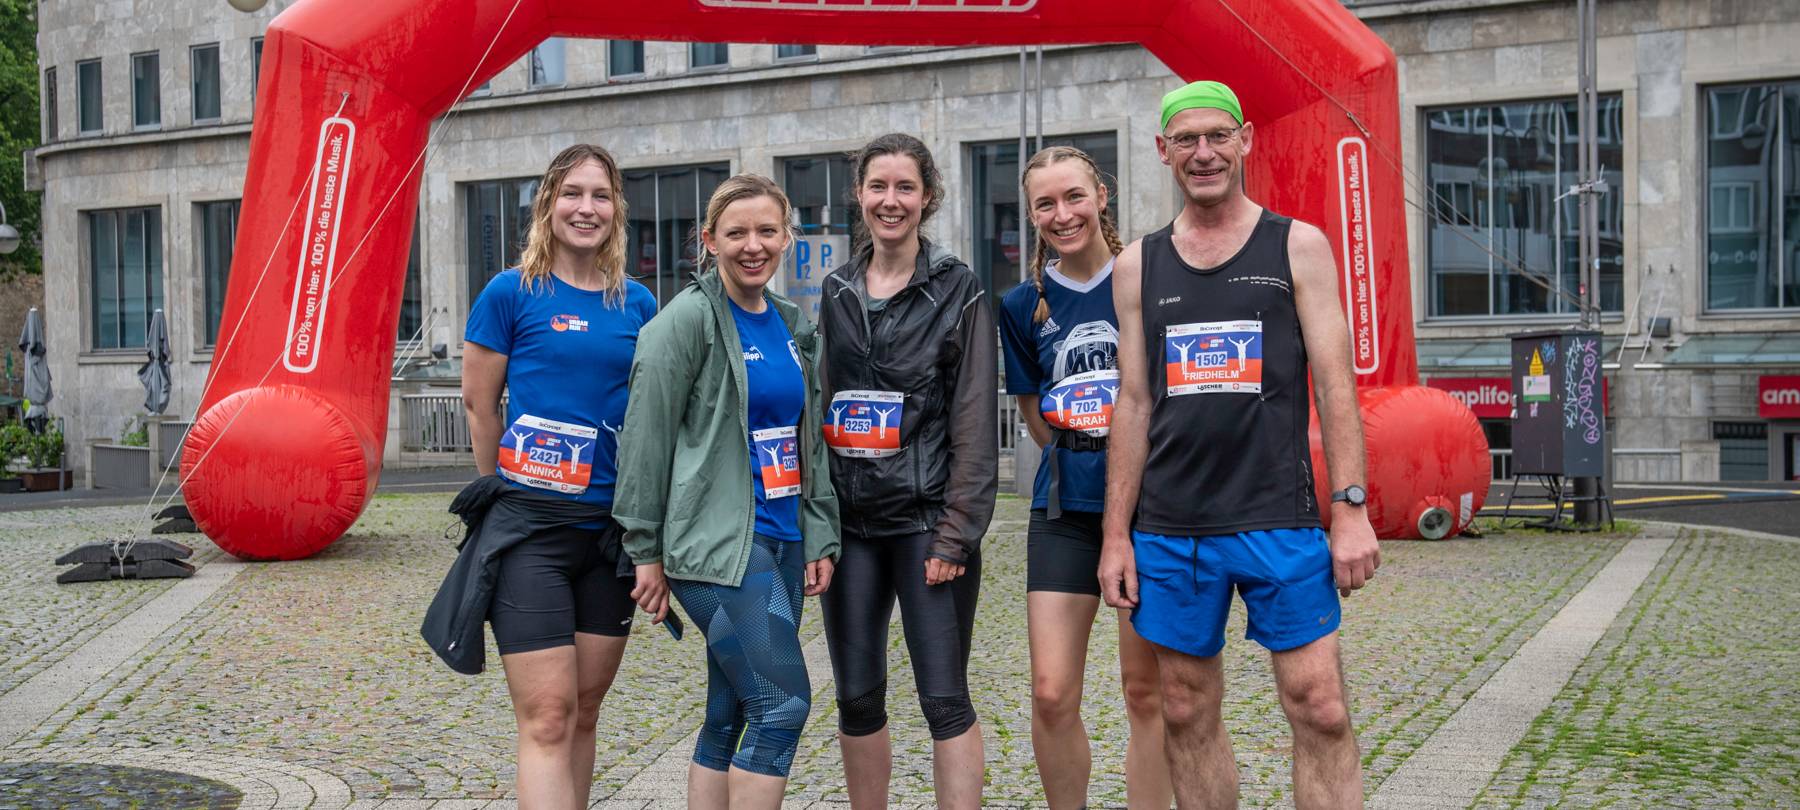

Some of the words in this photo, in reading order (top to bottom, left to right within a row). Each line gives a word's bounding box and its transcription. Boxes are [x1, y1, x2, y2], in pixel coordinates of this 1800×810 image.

[326, 133, 343, 173] Musik.
[1347, 151, 1360, 189] Musik.
[320, 175, 336, 209] beste
[1351, 190, 1362, 223] beste
[318, 211, 331, 229] die
[1353, 224, 1363, 241] die
[311, 230, 328, 267] 100%
[1353, 242, 1365, 277] 100%
[306, 269, 321, 295] hier.
[1356, 278, 1367, 303] hier.
[304, 297, 316, 317] von
[1360, 304, 1368, 324] von
[295, 321, 312, 358] 100%
[1040, 324, 1061, 337] adidas
[1359, 326, 1370, 360] 100%
[1196, 353, 1226, 367] 1502
[1184, 370, 1239, 381] FRIEDHELM
[1448, 385, 1510, 410] mplifo
[1762, 389, 1800, 405] am
[1075, 401, 1098, 414] 702
[845, 420, 871, 433] 3253
[1068, 415, 1107, 428] SARAH
[530, 449, 560, 466] 2421
[520, 463, 564, 480] ANNIKA
